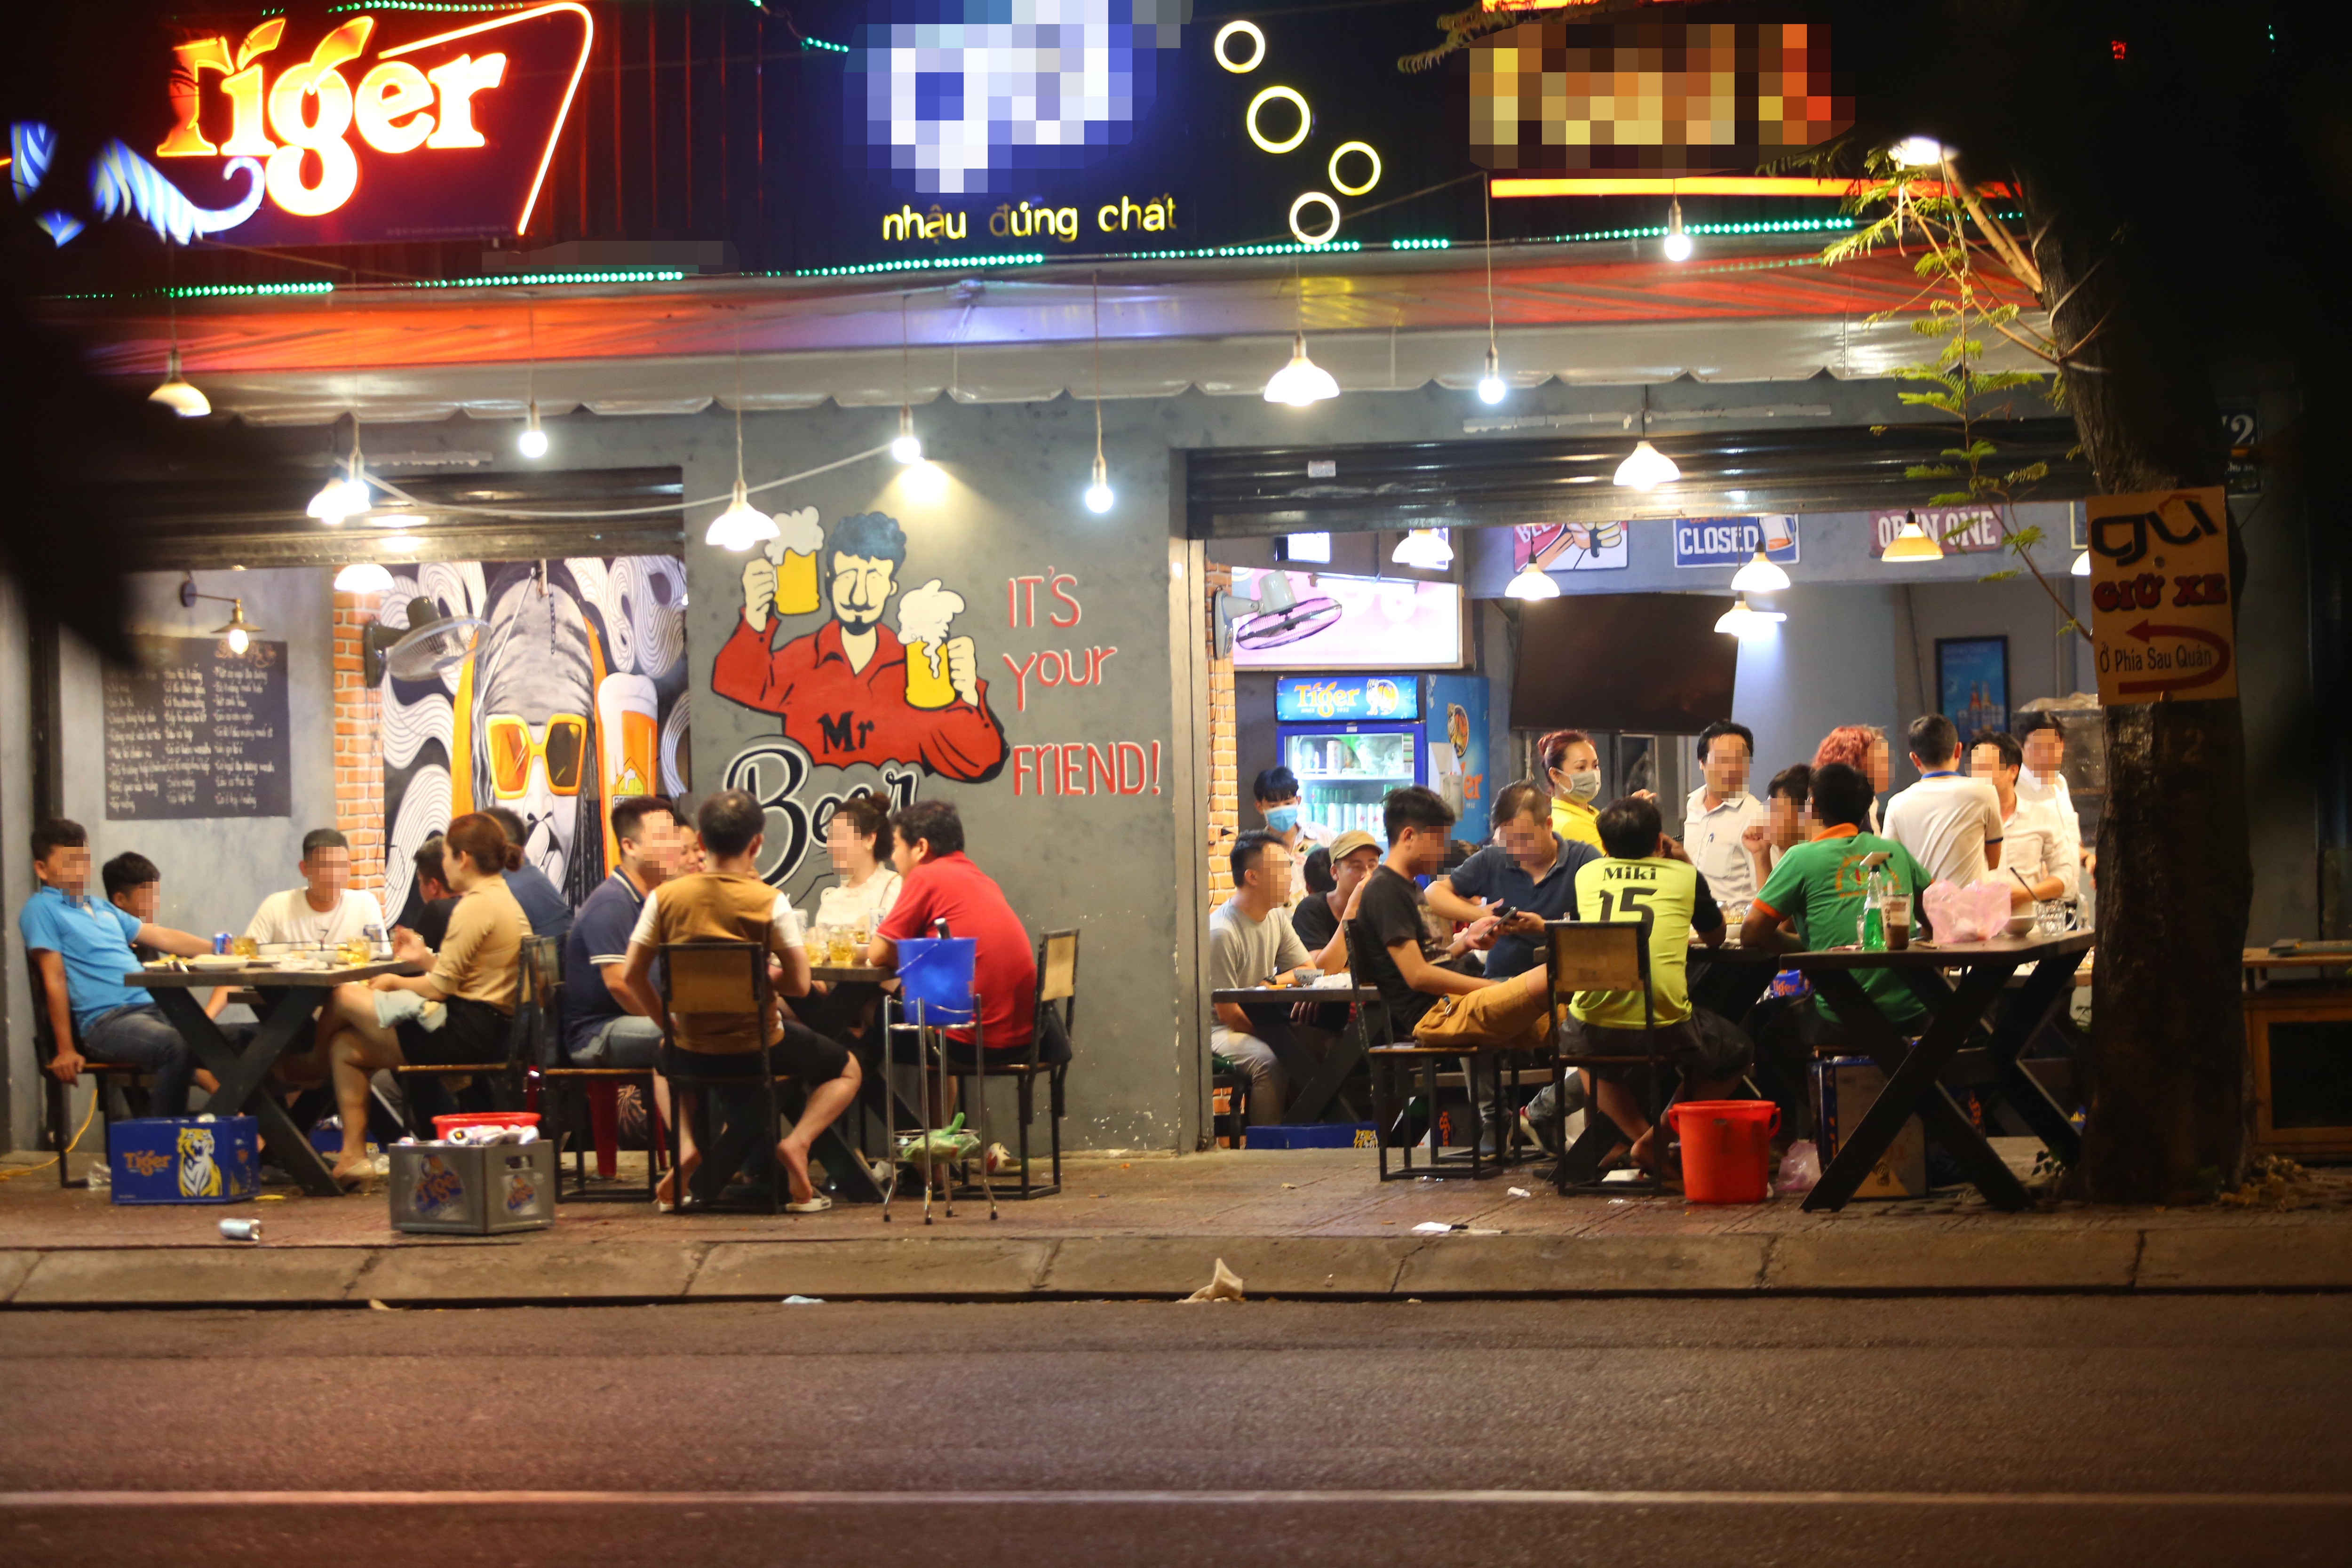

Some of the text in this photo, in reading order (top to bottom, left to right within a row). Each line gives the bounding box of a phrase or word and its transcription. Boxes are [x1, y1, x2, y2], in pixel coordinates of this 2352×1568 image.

[157, 16, 507, 216] Tiger
[883, 193, 1176, 244] nhậu đúng chất
[1679, 525, 1759, 555] CLOSED
[1945, 510, 1996, 547] ONE
[1008, 565, 1081, 628] IT'S
[2173, 573, 2227, 607] XE
[2114, 647, 2143, 672] Phía
[2147, 646, 2171, 670] Sau
[2176, 644, 2212, 669] Quán
[1294, 681, 1360, 718] Tiger
[817, 710, 875, 754] Mr
[1603, 865, 1656, 881] Miki
[1599, 887, 1659, 941] 15
[123, 1150, 173, 1176] Tiger
